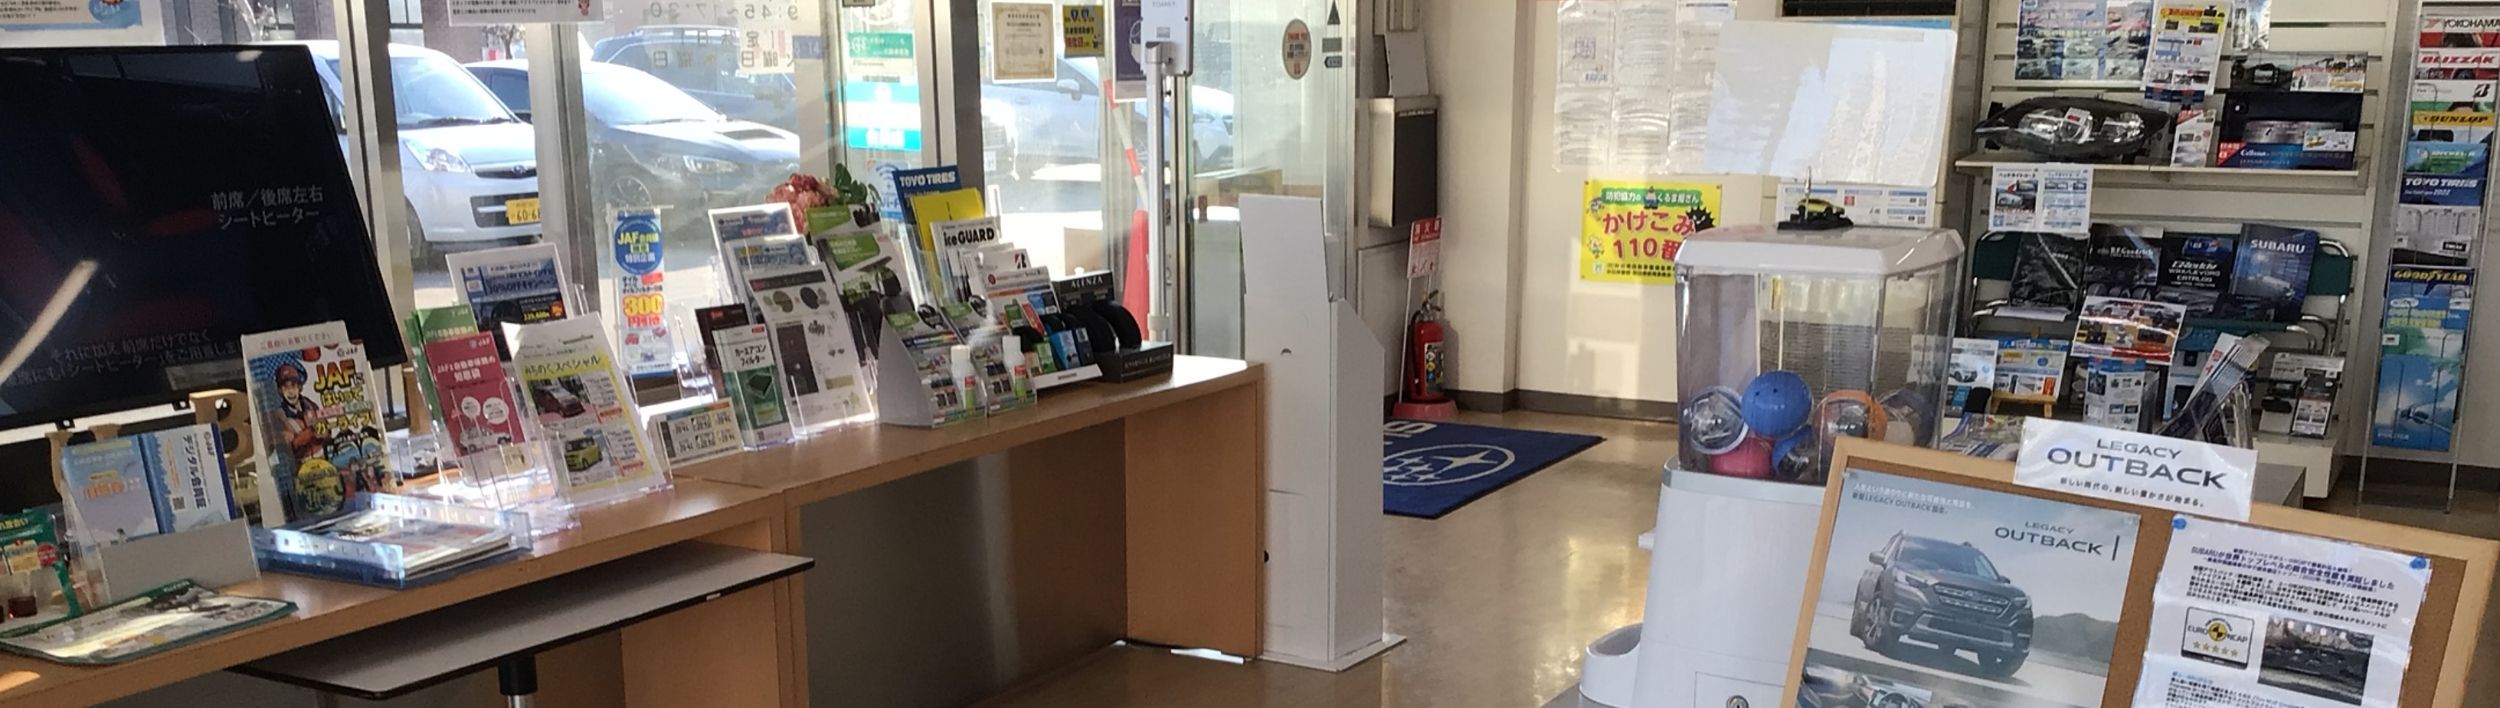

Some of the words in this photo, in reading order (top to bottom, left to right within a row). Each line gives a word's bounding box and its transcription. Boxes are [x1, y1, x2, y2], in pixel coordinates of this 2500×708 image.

[2421, 55, 2496, 65] BLIZZAK
[2430, 115, 2490, 124] DUNLOP
[899, 174, 926, 187] TOYO
[925, 170, 956, 184] TIRES
[2405, 178, 2439, 187] TOYO
[2440, 179, 2479, 188] TIRES
[218, 209, 320, 231] シートヒーター
[1602, 209, 1696, 236] かけこみ
[943, 227, 996, 248] iceGUARD
[2249, 239, 2307, 255] SUBARU
[1612, 237, 1682, 261] 110番
[1070, 275, 1104, 289] ALENZA
[2393, 268, 2468, 283] GOODYEAR
[622, 293, 665, 316] 300
[2096, 437, 2183, 460] LEGACY
[2046, 446, 2228, 490] OUTBACK
[2025, 520, 2075, 535] LEGACY
[1994, 526, 2104, 556] OUTBACK
